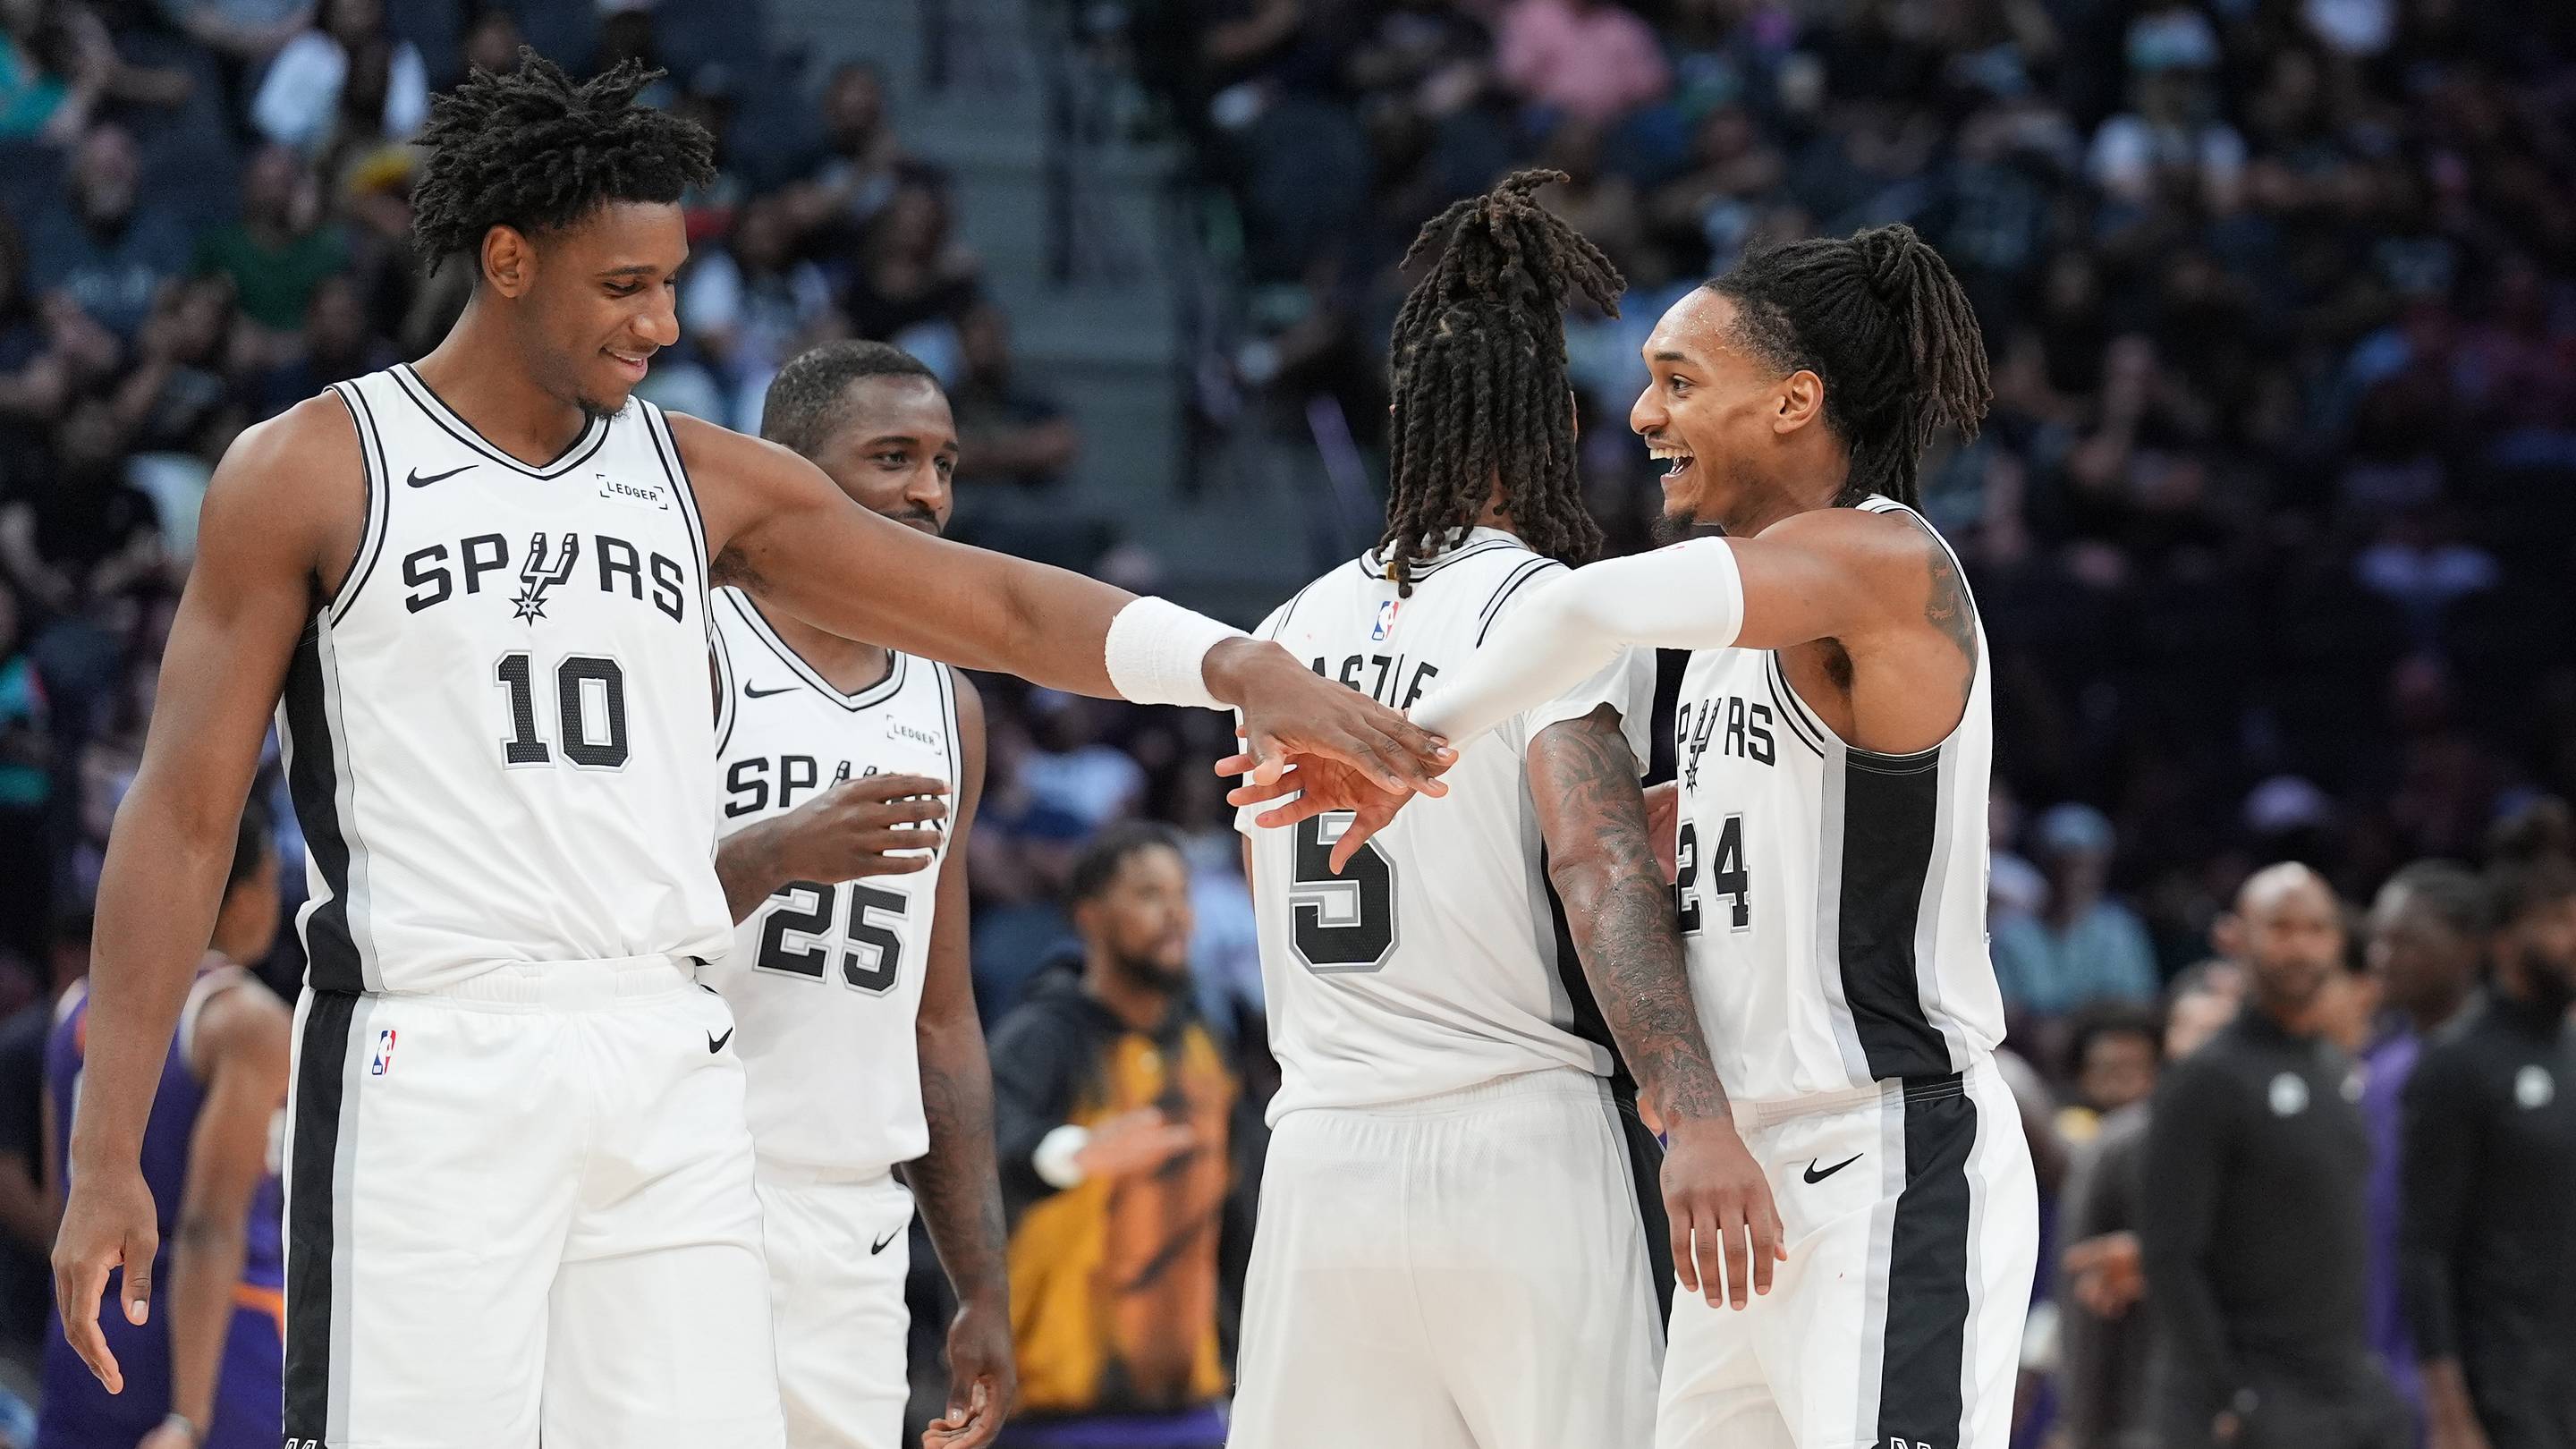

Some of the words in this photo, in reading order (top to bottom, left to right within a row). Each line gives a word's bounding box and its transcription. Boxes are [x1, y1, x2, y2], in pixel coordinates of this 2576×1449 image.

[606, 480, 658, 503] LEDGER
[402, 532, 684, 627] SPURS
[493, 650, 632, 773] 10
[894, 723, 936, 746] LEDGER
[1676, 697, 1775, 797] PURS
[1289, 789, 1400, 974] 5
[1676, 811, 1750, 936] 24
[752, 880, 911, 997] 25
